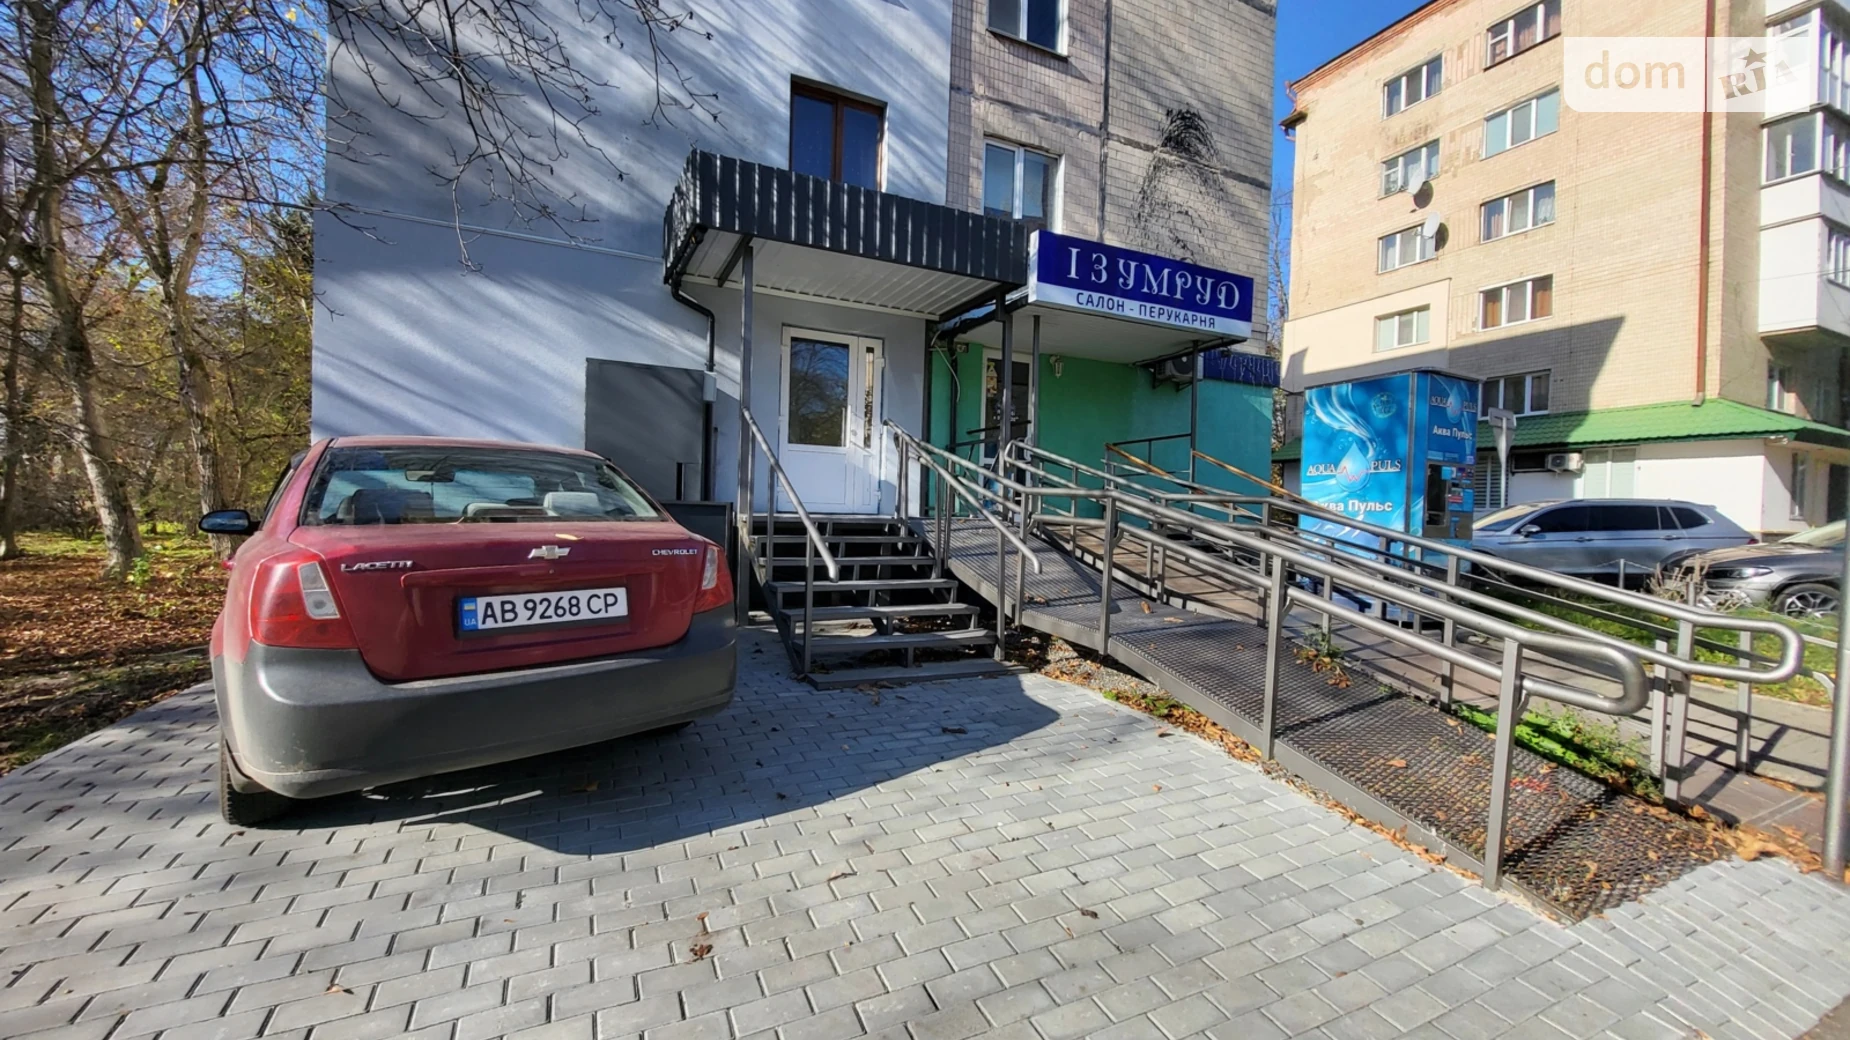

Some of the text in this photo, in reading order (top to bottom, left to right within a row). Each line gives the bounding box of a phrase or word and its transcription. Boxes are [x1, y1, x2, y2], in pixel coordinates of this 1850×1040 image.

[1076, 292, 1125, 313] САЛОН
[1139, 304, 1215, 329] ПЕРУКАРНЯ
[1432, 425, 1473, 440] Аква Пульс
[1306, 460, 1401, 474] AQUA PULS
[1348, 499, 1393, 514] Пульс
[652, 548, 698, 556] CHEVROLET
[481, 592, 619, 625] AB 9268 CP
[464, 618, 477, 626] UA
